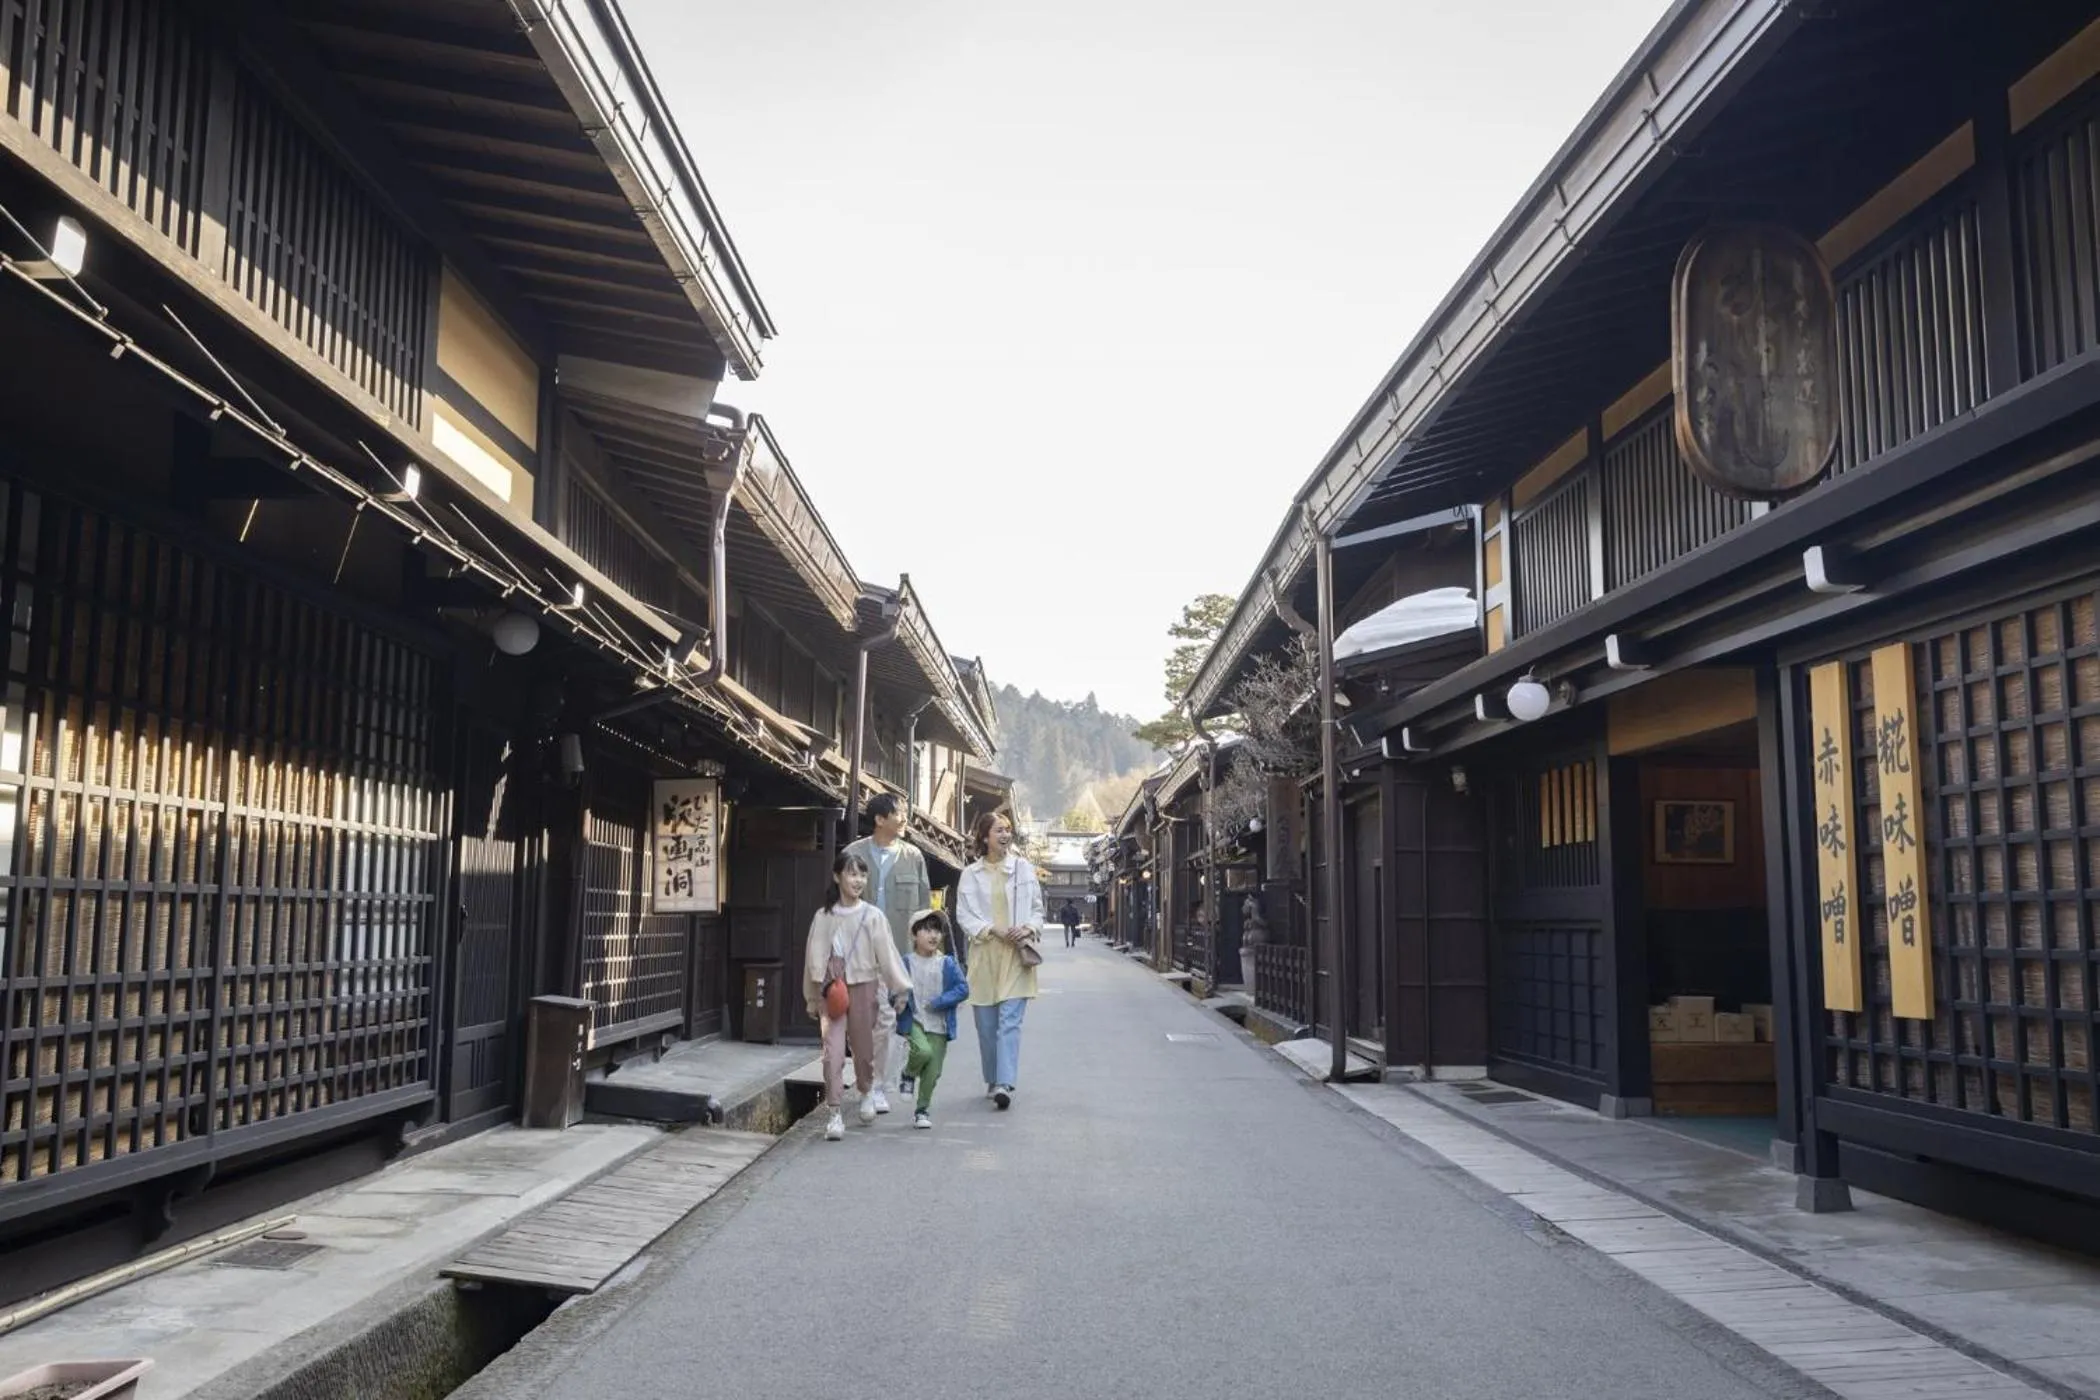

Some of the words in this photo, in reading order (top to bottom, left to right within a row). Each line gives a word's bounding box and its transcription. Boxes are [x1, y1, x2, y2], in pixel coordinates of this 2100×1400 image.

[1816, 727, 1847, 945] 赤味噌
[1877, 707, 1917, 947] 糀味噌
